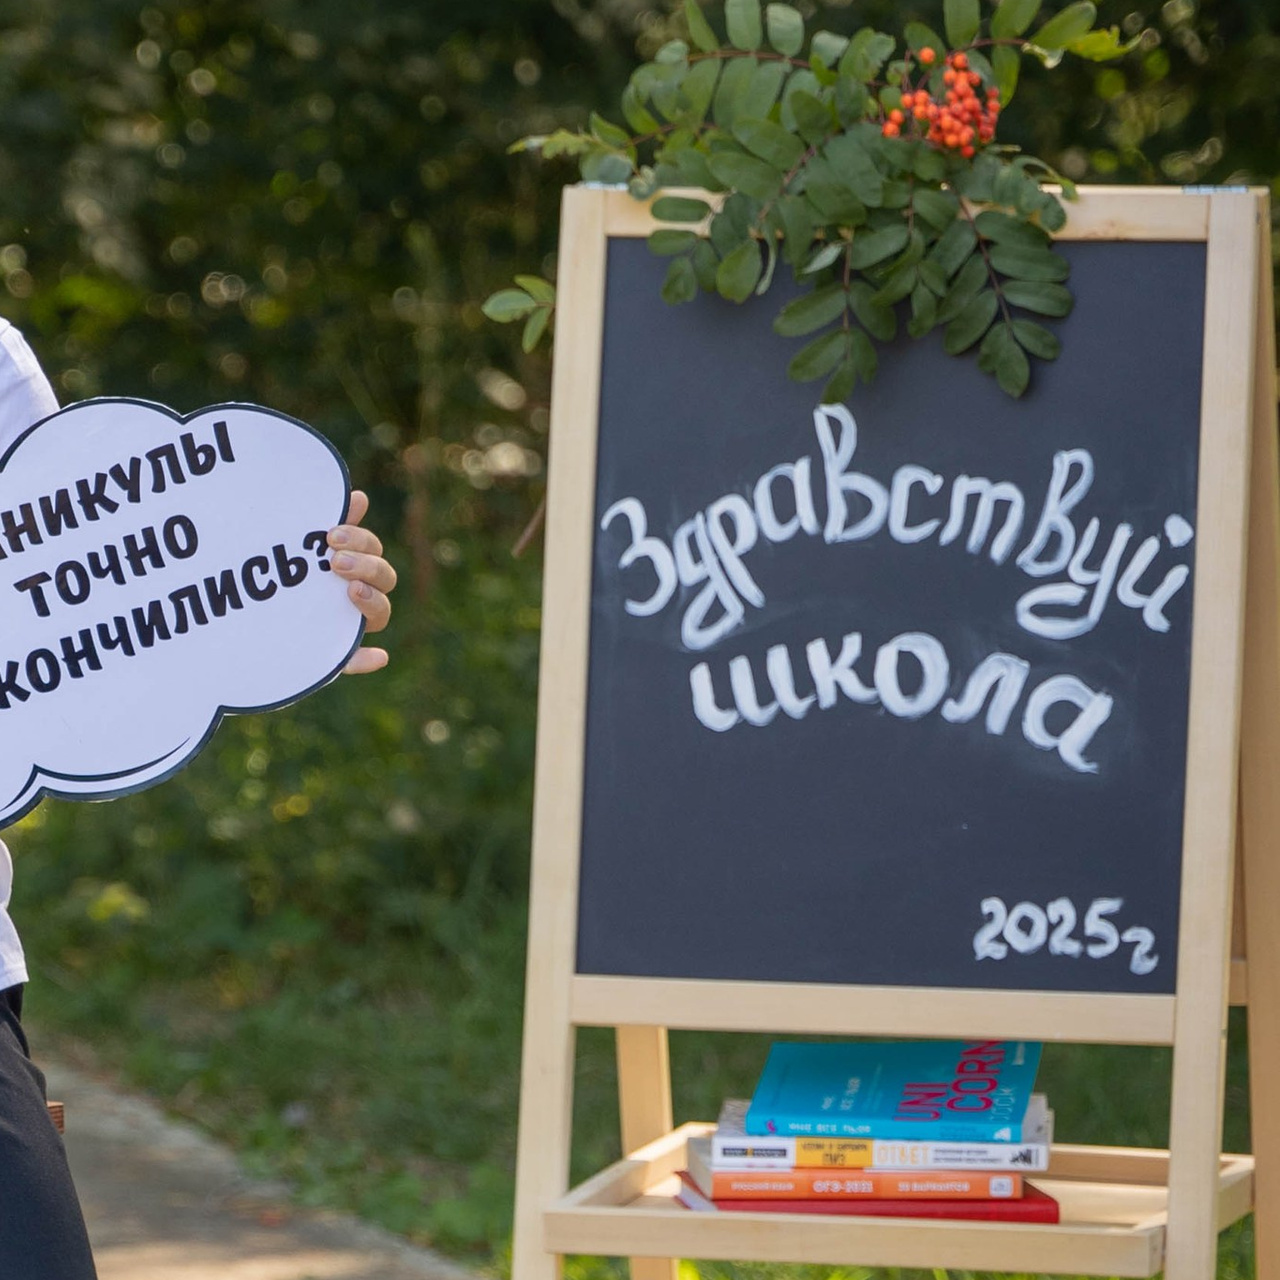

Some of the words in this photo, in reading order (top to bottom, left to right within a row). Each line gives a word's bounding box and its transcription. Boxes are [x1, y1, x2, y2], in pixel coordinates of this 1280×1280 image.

[13, 514, 199, 617] ТОЧНО
[601, 403, 1194, 651] Здравствуй
[689, 631, 1113, 774] школа
